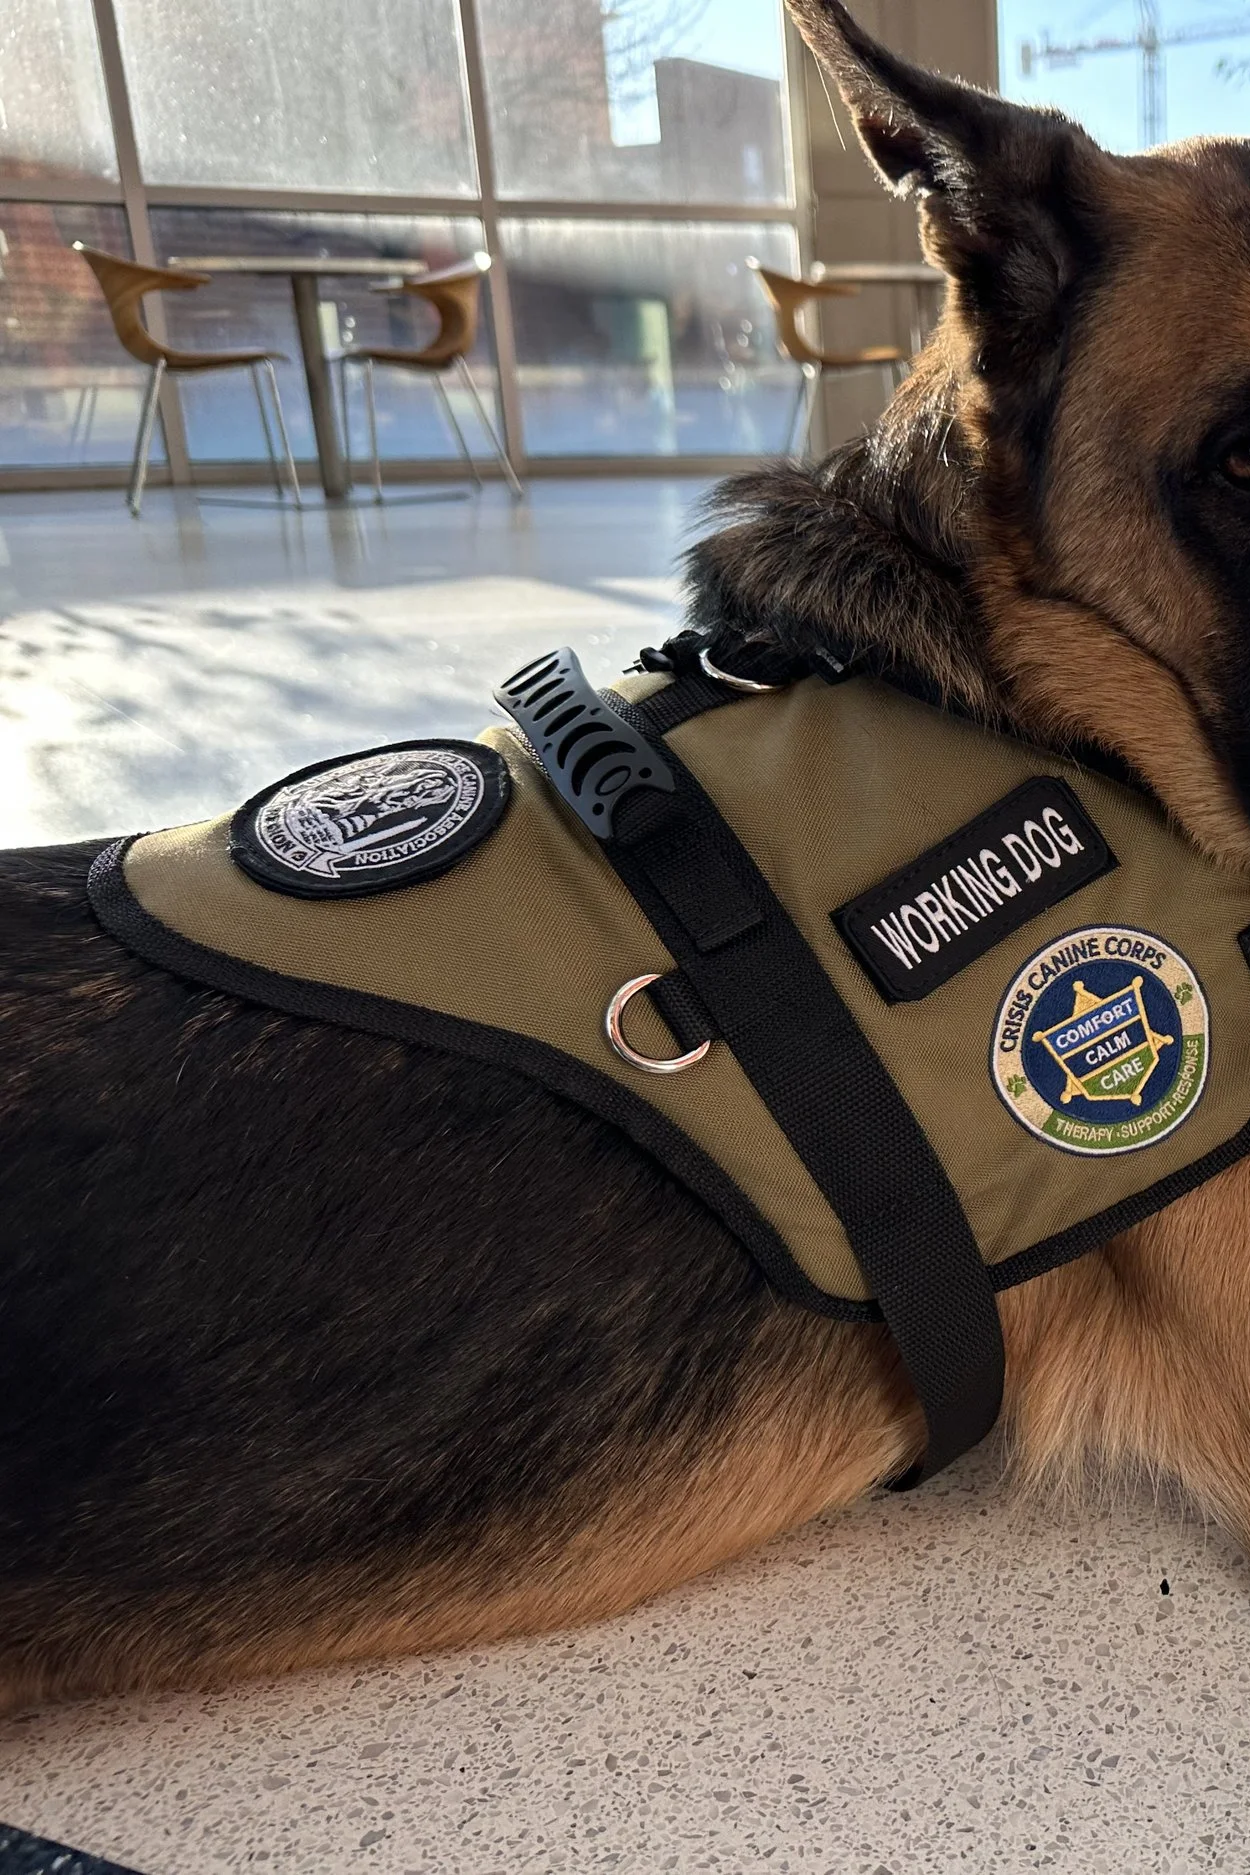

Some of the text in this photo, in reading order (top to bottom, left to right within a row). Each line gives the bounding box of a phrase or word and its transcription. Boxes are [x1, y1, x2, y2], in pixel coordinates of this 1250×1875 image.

[455, 773, 477, 812] CANINE
[355, 812, 464, 866] ASSOCIATION
[870, 806, 1085, 970] WORKING DOG
[1000, 936, 1166, 1053] CRISIS CANINE CORPS
[1055, 997, 1134, 1049] COMFORT
[1085, 1031, 1132, 1065] CALM
[1100, 1057, 1144, 1090] CARE
[1056, 1119, 1113, 1142] THERAPY
